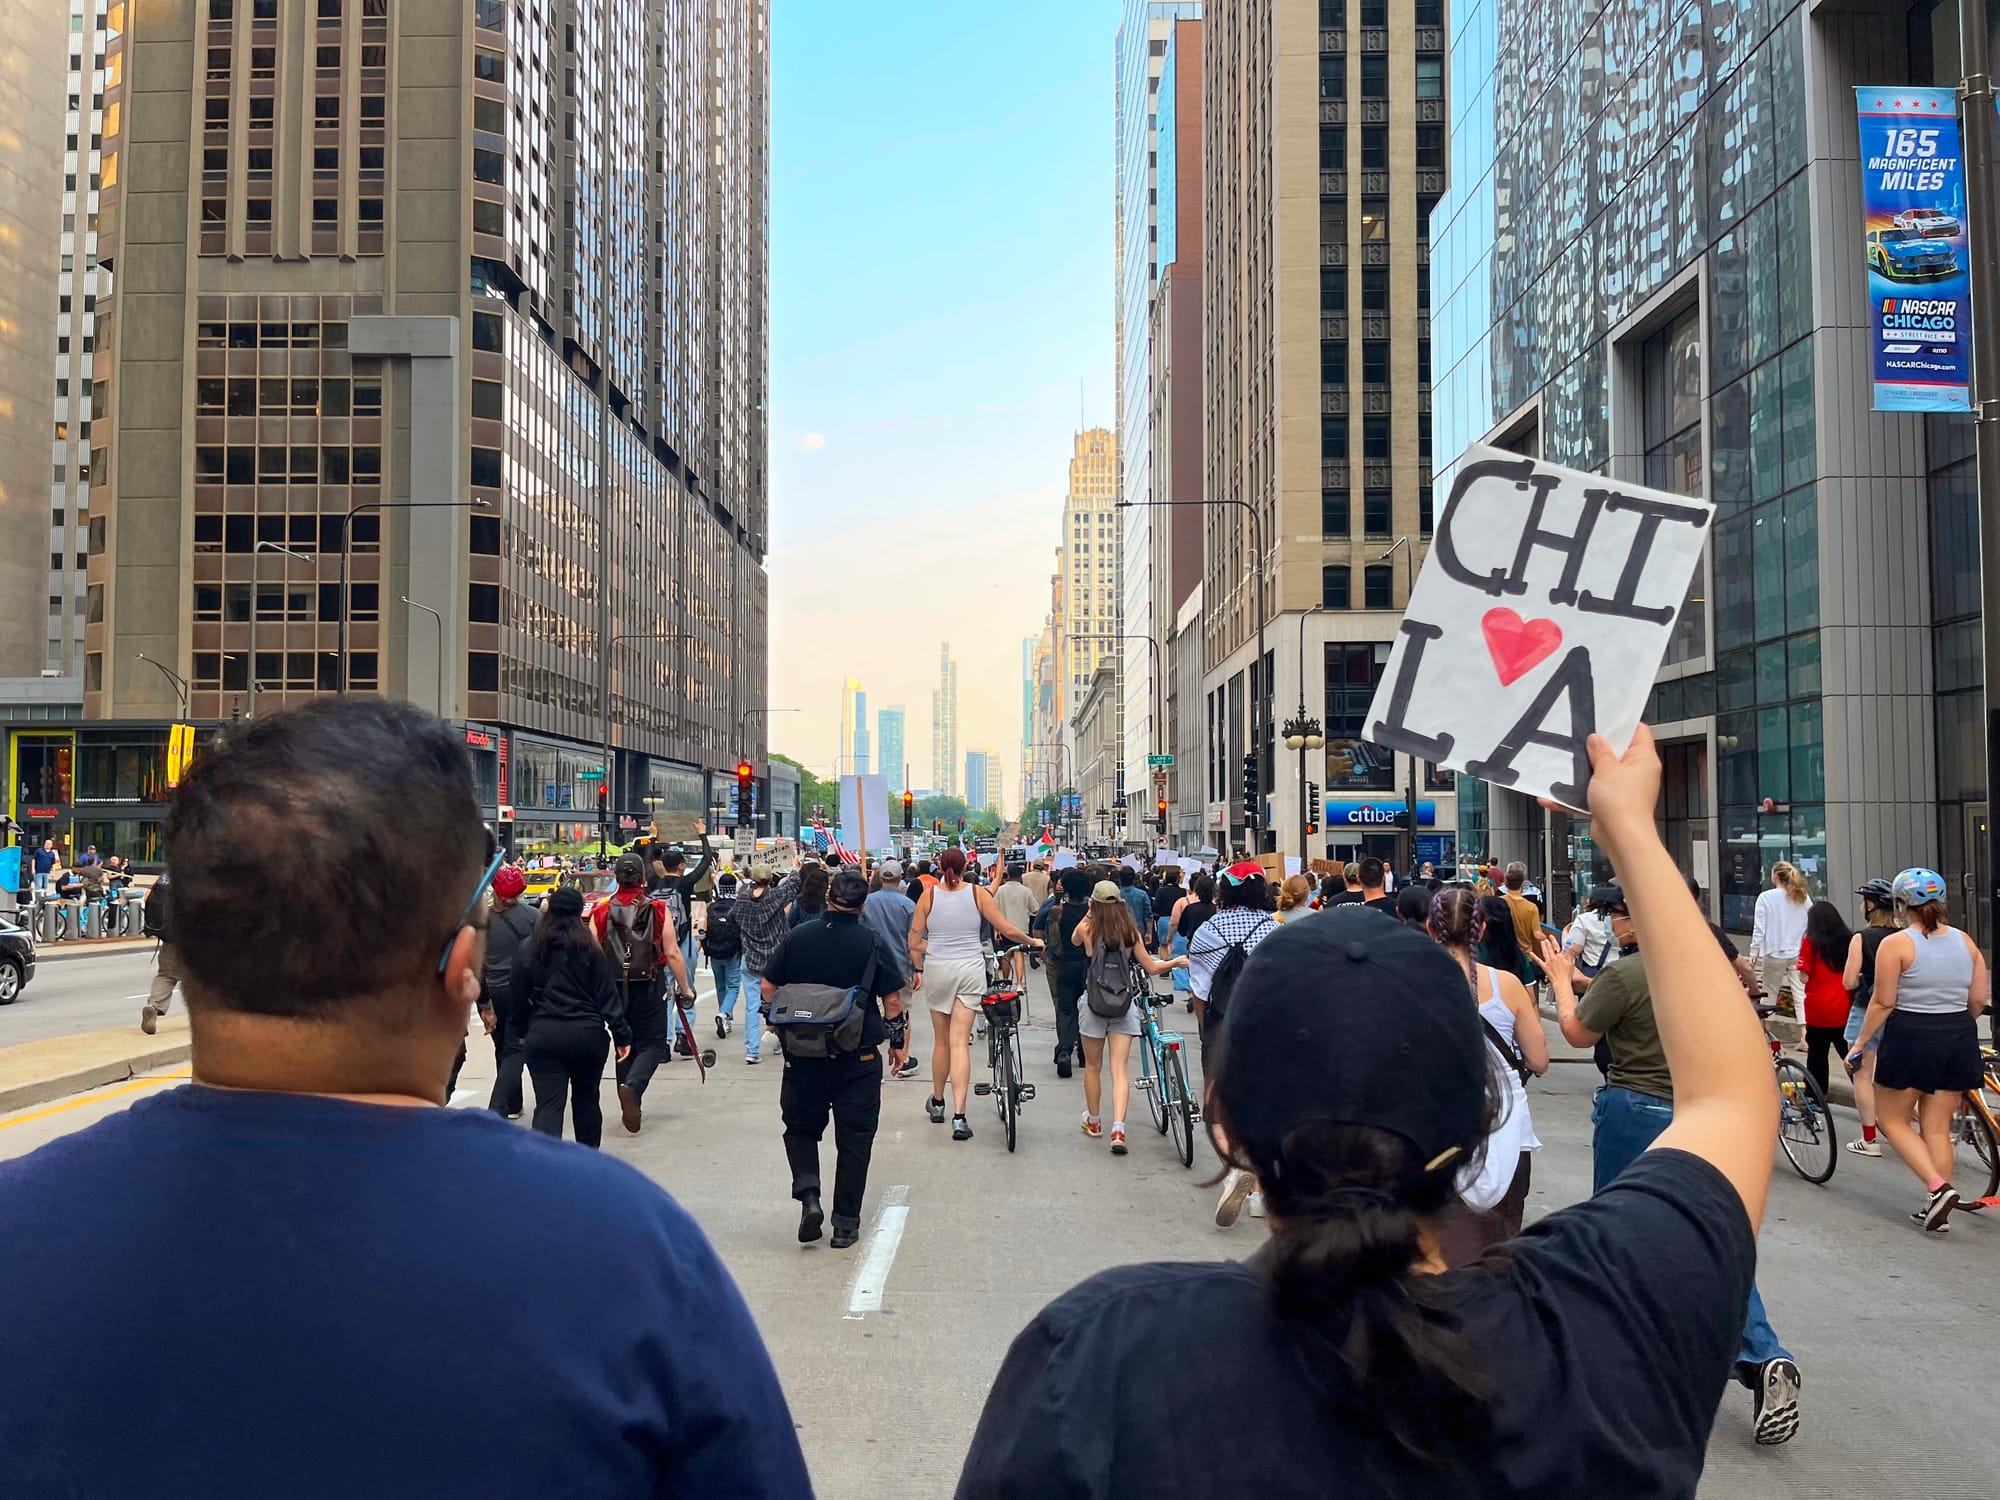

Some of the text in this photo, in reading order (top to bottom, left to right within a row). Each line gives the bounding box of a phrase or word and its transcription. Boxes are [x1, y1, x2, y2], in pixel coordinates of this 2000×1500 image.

[1885, 129, 1939, 158] 165
[1868, 158, 1957, 171] MAGNIFICENT
[1880, 171, 1945, 191] MILES
[1901, 300, 1956, 316] NASCAR
[1882, 314, 1955, 330] CHICAGO
[1436, 459, 1709, 626] CHI
[1348, 806, 1409, 823] citiba
[765, 856, 778, 864] NOT
